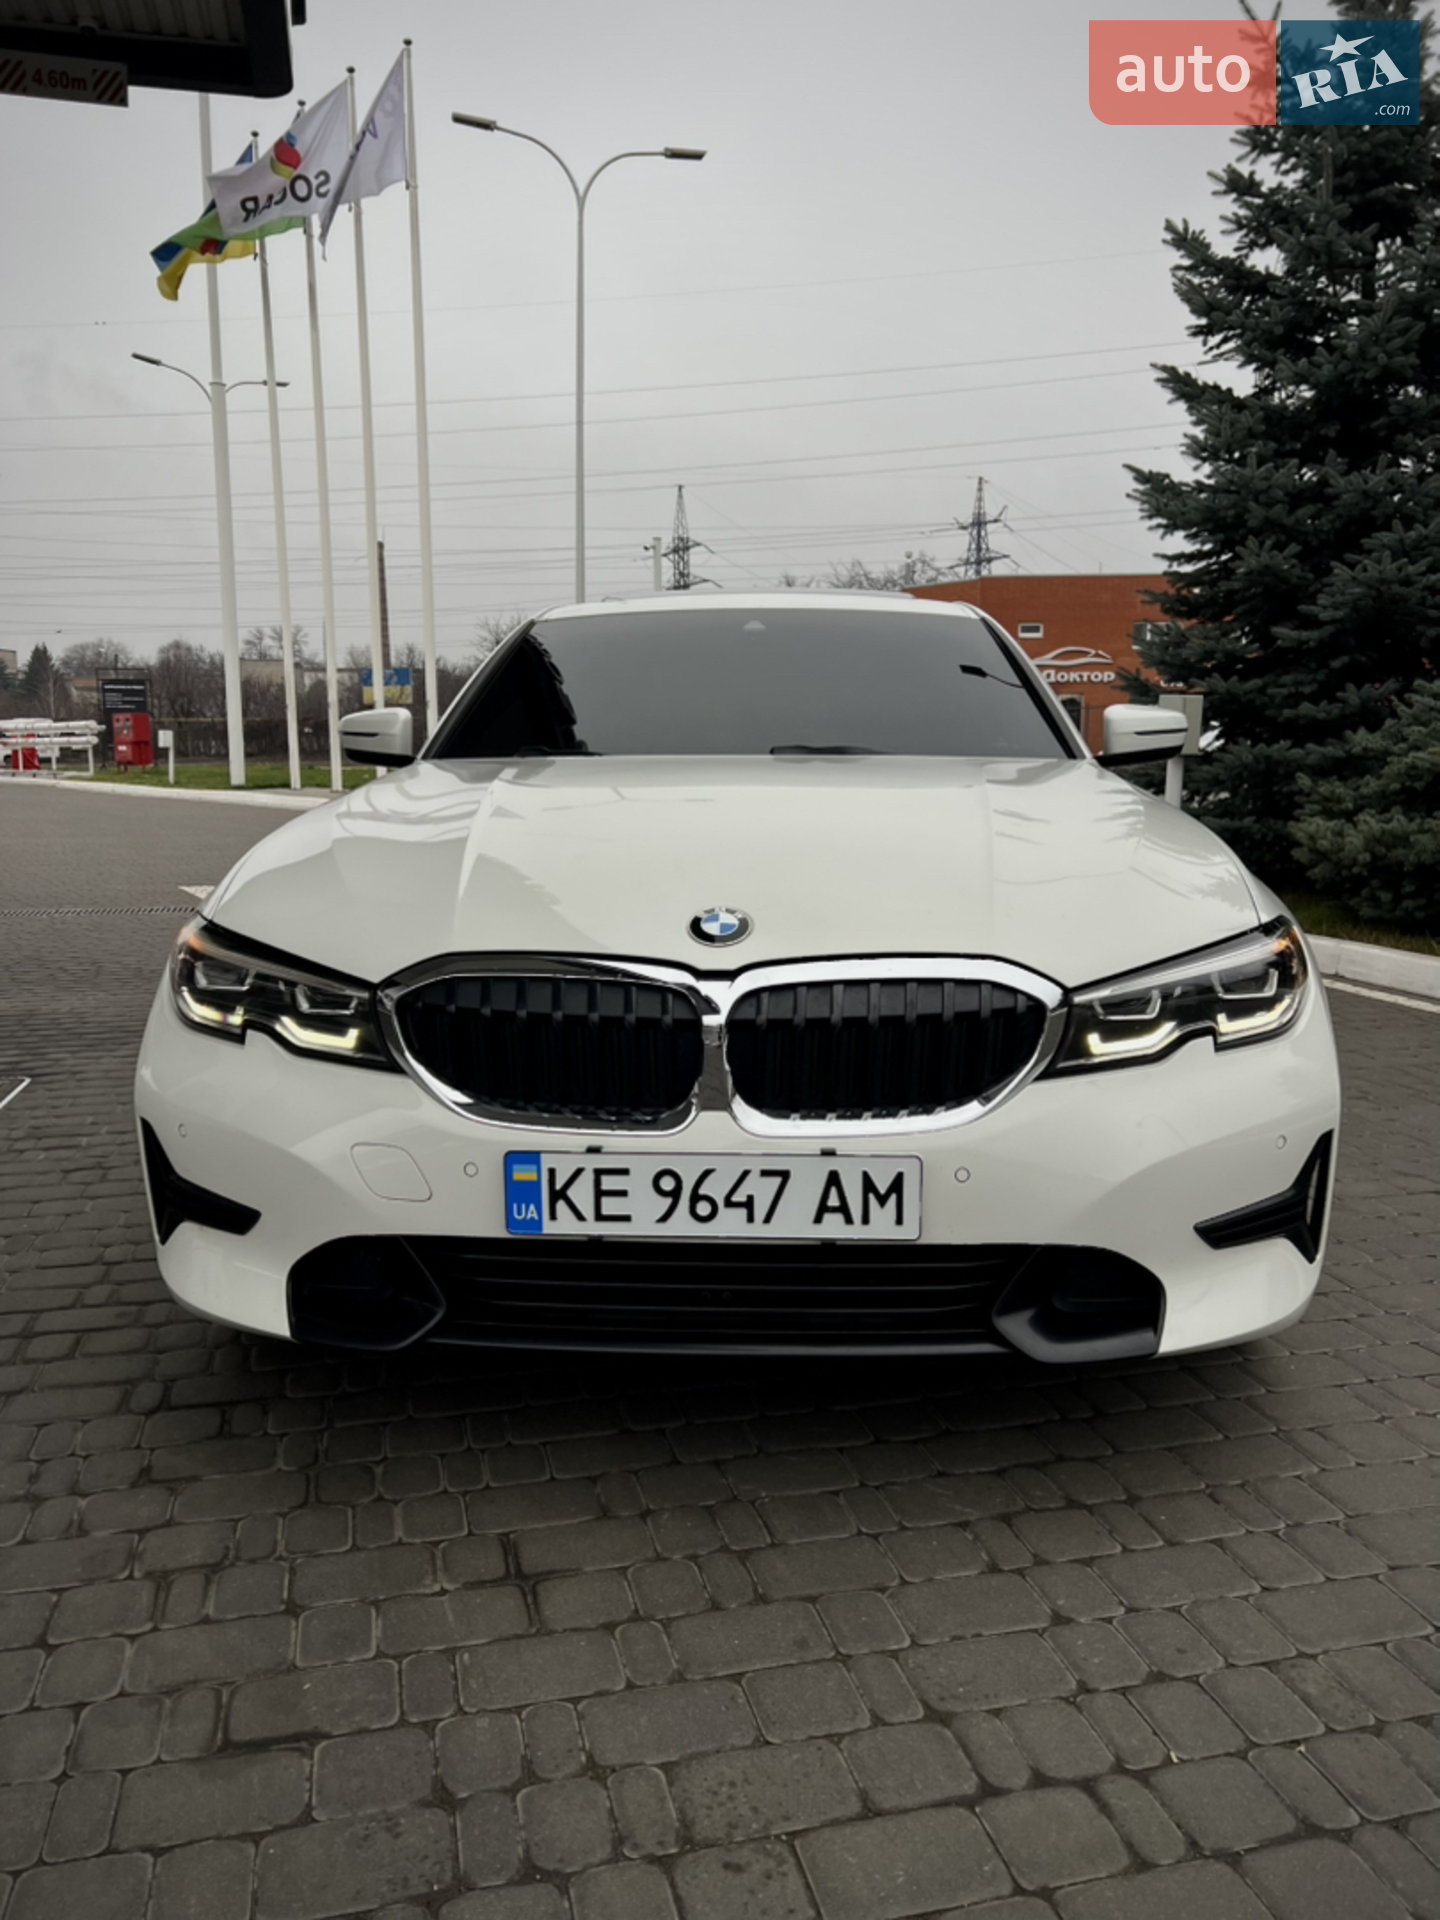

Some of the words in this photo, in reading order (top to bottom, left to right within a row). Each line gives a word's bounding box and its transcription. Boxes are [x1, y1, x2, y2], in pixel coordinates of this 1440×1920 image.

[32, 68, 88, 92] 4.60m
[547, 1166, 632, 1222] KE
[651, 1167, 791, 1224] 9647
[812, 1169, 904, 1226] AM
[512, 1202, 539, 1221] UA
